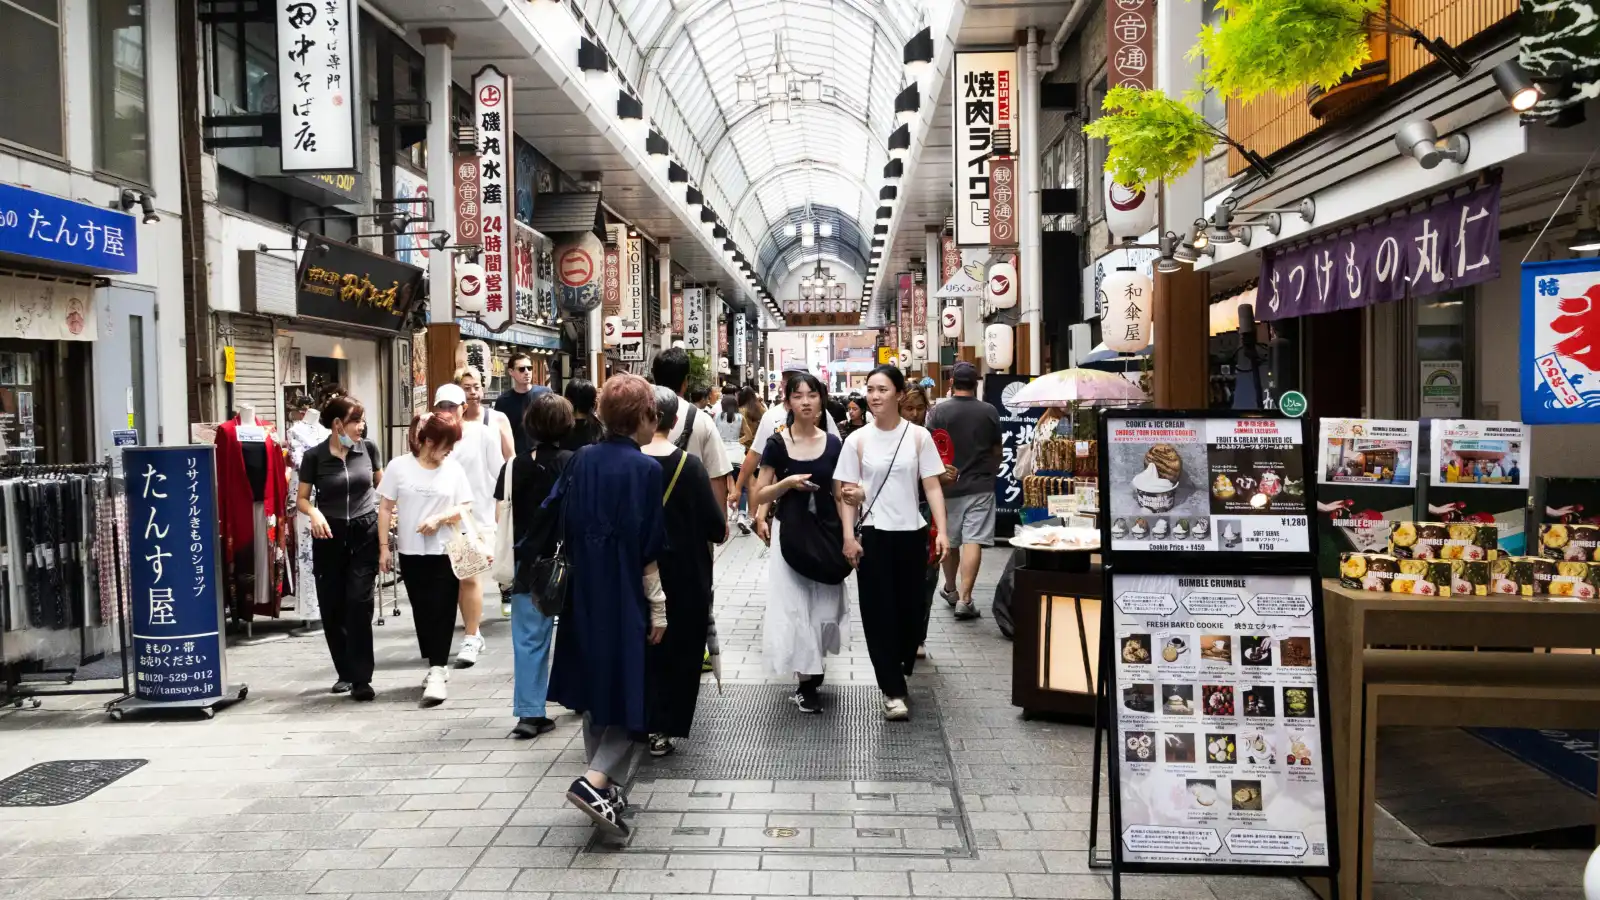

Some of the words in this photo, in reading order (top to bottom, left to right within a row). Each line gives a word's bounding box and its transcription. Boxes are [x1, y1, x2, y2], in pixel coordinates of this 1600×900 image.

[1114, 0, 1147, 91] 音通
[285, 3, 317, 152] 田中そば店
[481, 112, 501, 205] 磯丸水産
[459, 163, 478, 238] 観音通り
[993, 166, 1012, 240] 観音通り
[28, 208, 125, 257] たんす屋
[483, 216, 503, 312] 24時間営業
[1124, 283, 1142, 341] 和傘屋
[141, 463, 177, 626] たんす屋
[186, 457, 206, 597] リサイクルきものショップ
[1281, 518, 1306, 527] ¥1,280
[1333, 519, 1363, 527] RUMBLE
[1363, 520, 1390, 529] CRUM
[1178, 578, 1207, 587] RUMBLE
[1210, 579, 1246, 588] CRUMBLE
[1367, 571, 1393, 579] RUMBLE
[140, 655, 207, 668] お売りください
[145, 641, 196, 654] きもの・帯
[138, 683, 213, 695] http://tansuya.jp
[145, 670, 213, 682] 0120-529-012
